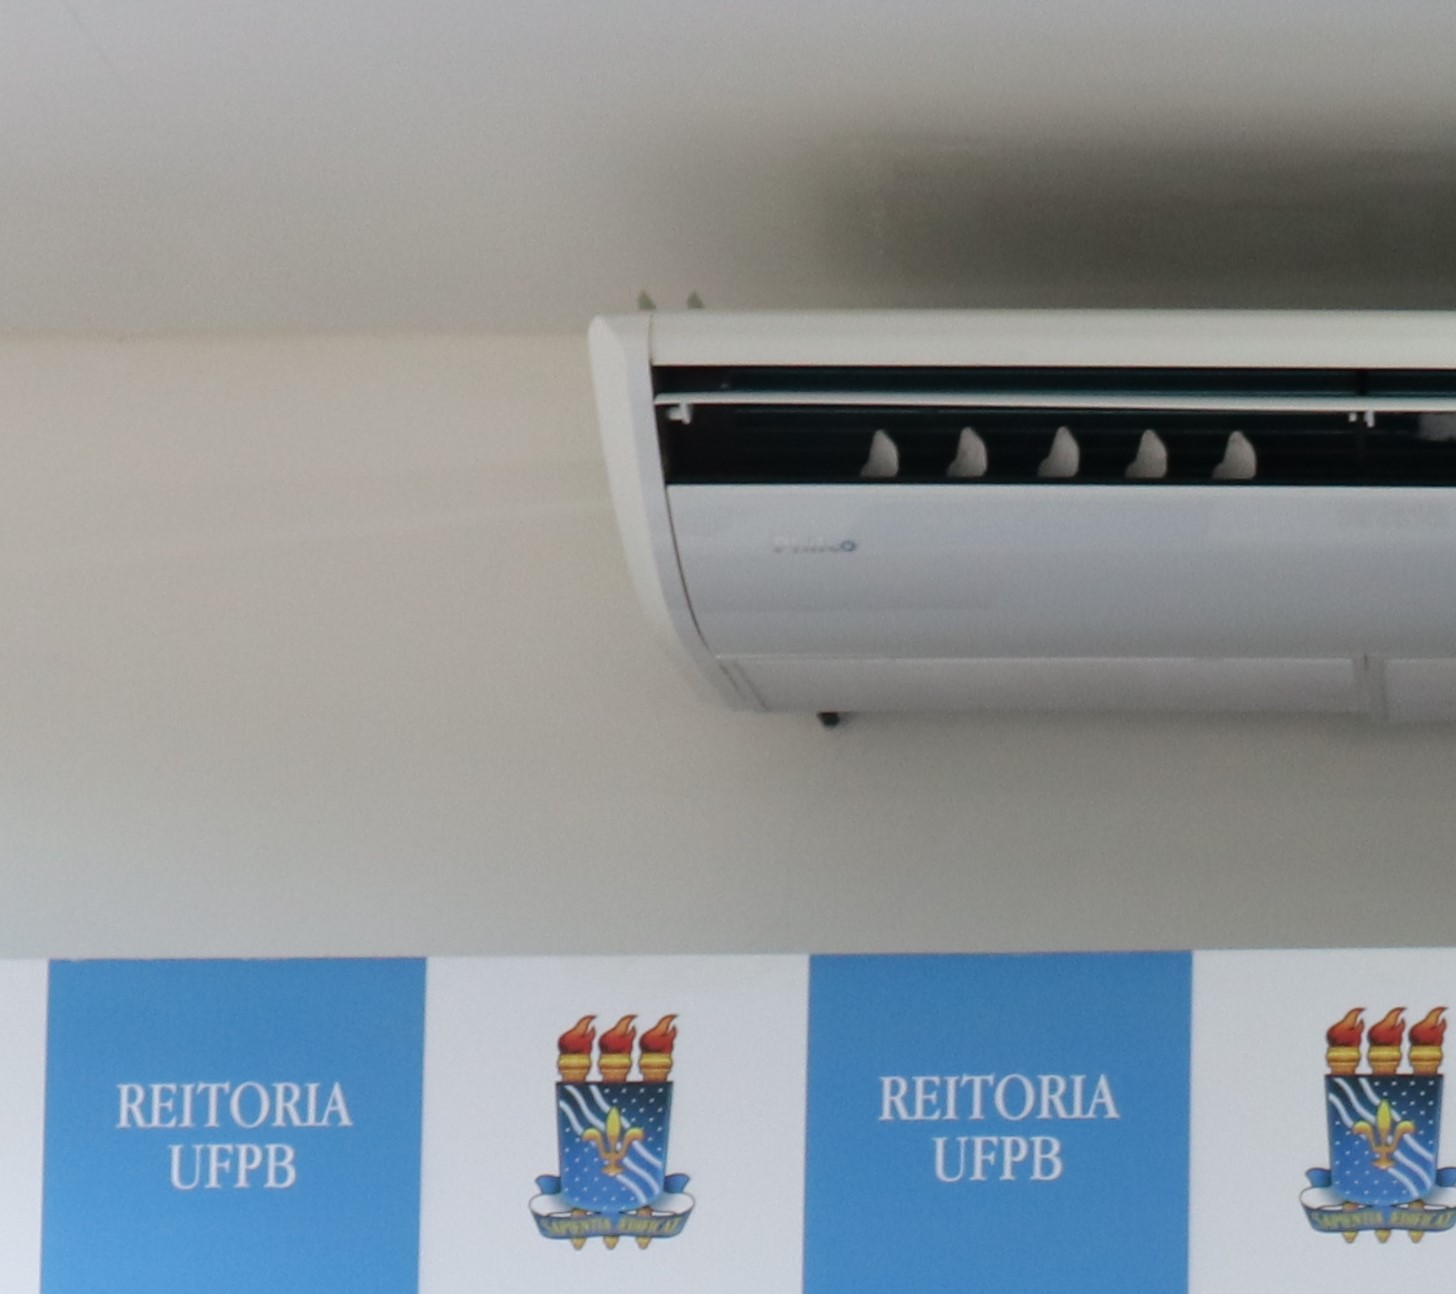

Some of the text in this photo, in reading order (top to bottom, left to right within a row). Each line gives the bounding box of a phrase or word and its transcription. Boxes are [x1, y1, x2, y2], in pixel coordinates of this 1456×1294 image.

[116, 1081, 353, 1129] REITORIA
[879, 1073, 1121, 1121] REITORIA
[170, 1143, 297, 1191] UFPB
[934, 1135, 1064, 1183] UFPB
